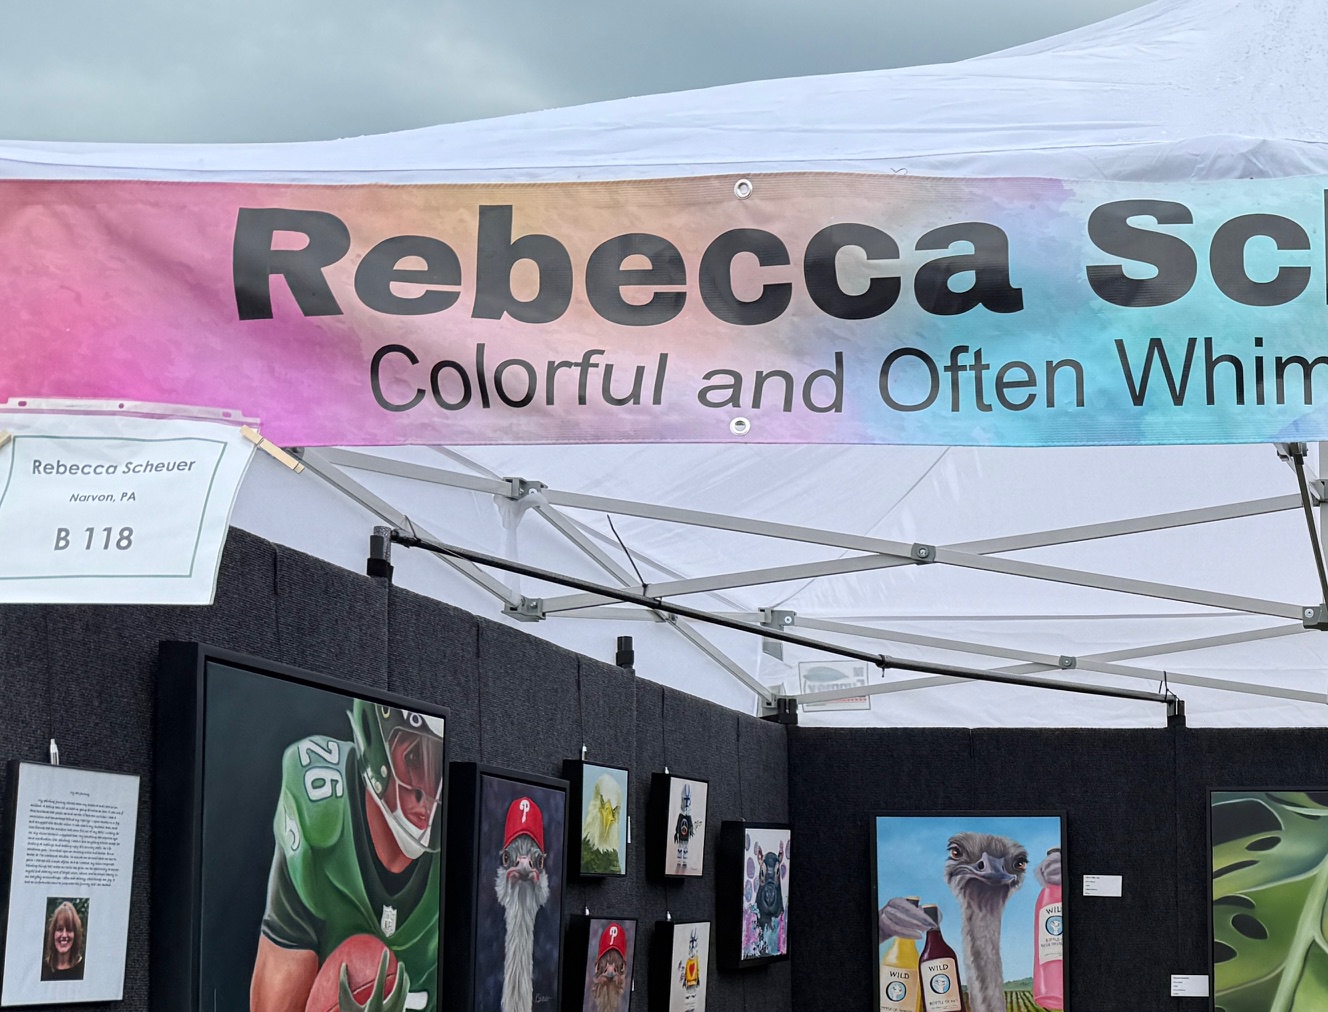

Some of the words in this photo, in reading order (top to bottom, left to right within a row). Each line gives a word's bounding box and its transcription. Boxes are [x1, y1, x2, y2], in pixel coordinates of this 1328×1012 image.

[232, 204, 1025, 326] Rebecca
[369, 342, 669, 412] Colorful
[697, 351, 844, 414] and
[879, 343, 1085, 412] Often
[31, 459, 118, 475] Rebecca
[121, 458, 196, 474] Scheuer
[69, 492, 116, 503] Narvon,
[119, 491, 136, 502] PA
[53, 527, 71, 551] B
[84, 526, 134, 551] 118
[298, 739, 344, 802] 26
[519, 799, 530, 824] P
[609, 926, 618, 946] P
[889, 970, 910, 980] WILD
[928, 963, 949, 972] WILD
